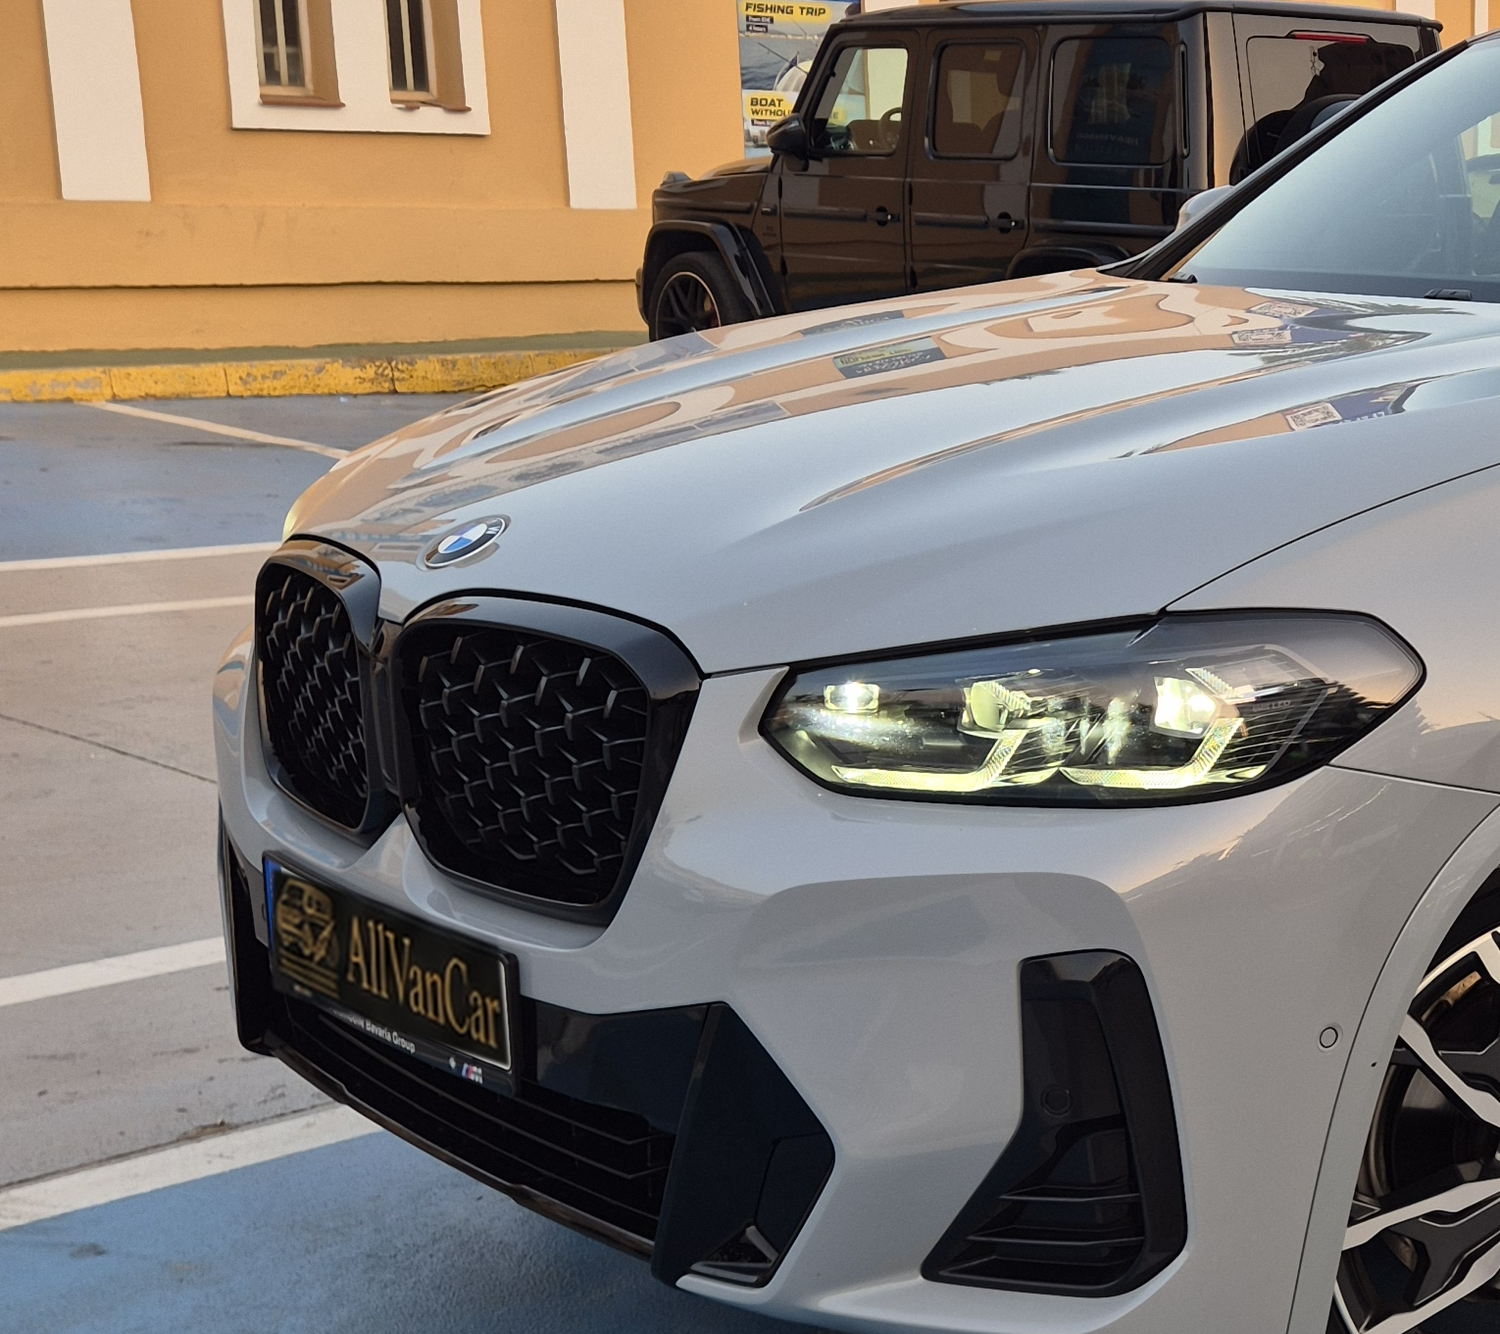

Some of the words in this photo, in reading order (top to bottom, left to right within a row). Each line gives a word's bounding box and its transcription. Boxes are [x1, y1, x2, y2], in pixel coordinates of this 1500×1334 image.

[745, 2, 794, 16] FISHING
[798, 6, 826, 17] TRIP
[750, 97, 784, 107] BOAT
[751, 108, 793, 117] WITHOU
[392, 1030, 416, 1054] Group
